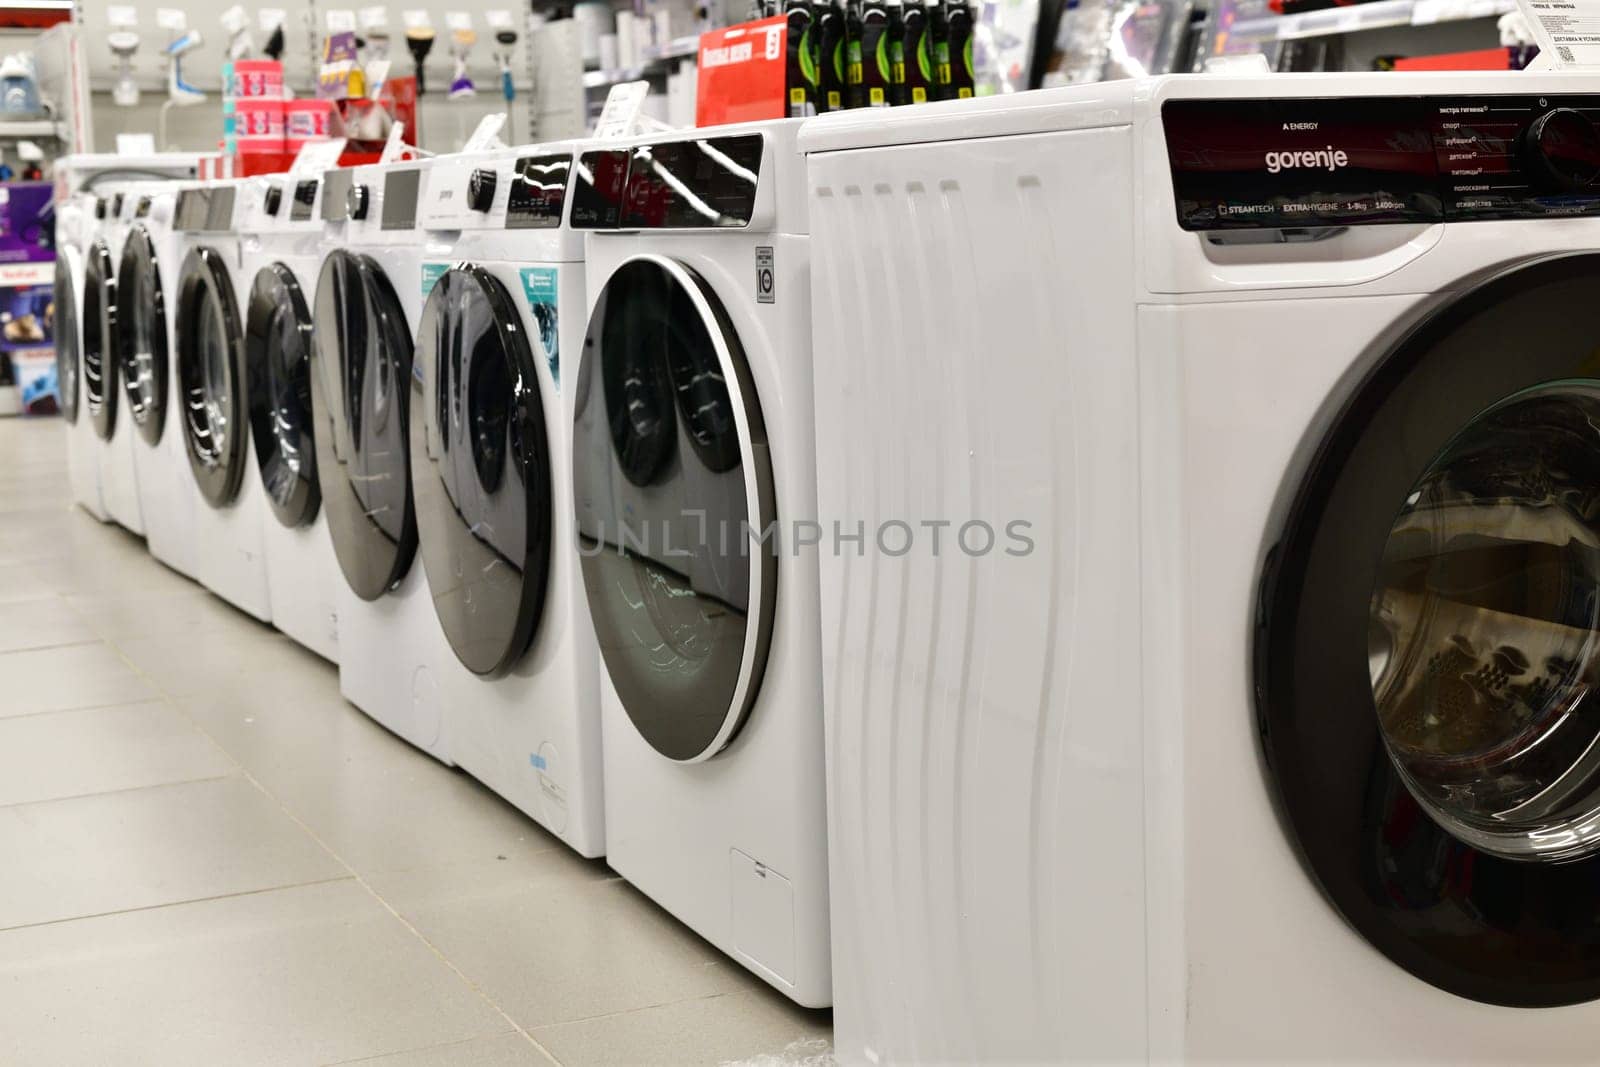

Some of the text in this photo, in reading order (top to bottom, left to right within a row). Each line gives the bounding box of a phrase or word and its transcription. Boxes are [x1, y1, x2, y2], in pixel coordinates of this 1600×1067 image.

[1290, 122, 1319, 130] ENERGY
[1265, 145, 1348, 173] gorenje
[1228, 204, 1275, 214] STEAMTECH
[1283, 202, 1339, 213] EXTRAHYGIENE
[1375, 201, 1405, 210] 1400rpm
